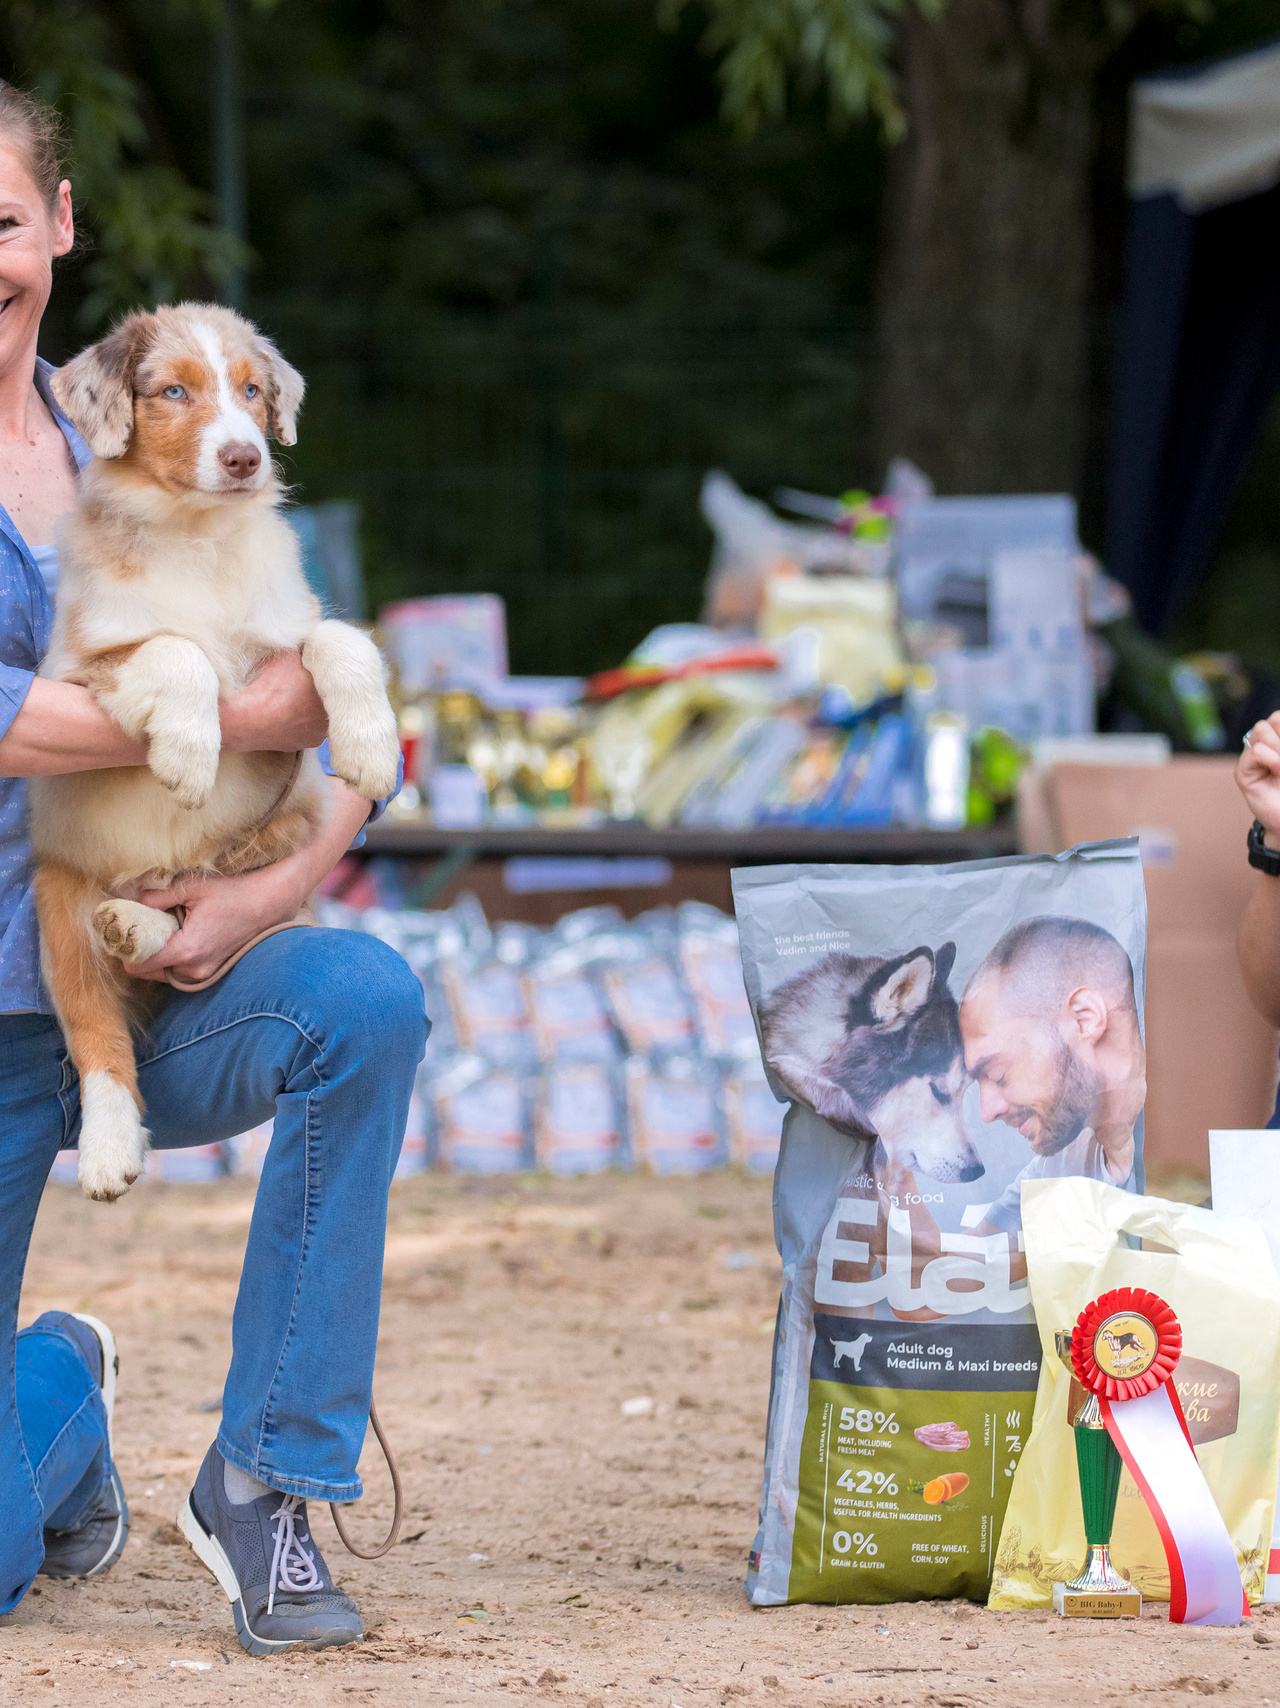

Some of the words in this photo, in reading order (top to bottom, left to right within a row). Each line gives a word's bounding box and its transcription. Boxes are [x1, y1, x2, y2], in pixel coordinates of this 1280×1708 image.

[774, 936, 791, 945] the
[793, 933, 814, 943] best
[816, 930, 850, 941] friends
[775, 945, 807, 956] Vadim
[809, 942, 827, 953] and
[829, 941, 851, 950] Nice
[904, 1191, 944, 1205] food
[814, 1198, 1032, 1315] Elá
[886, 1342, 924, 1354] Adult
[926, 1344, 953, 1358] dog
[886, 1357, 942, 1371] Medium
[944, 1360, 955, 1371] &
[958, 1360, 990, 1372] Maxi
[993, 1360, 1038, 1372] breeds
[839, 1407, 900, 1435] 58%
[819, 1429, 827, 1463] NATURAL
[837, 1446, 857, 1455] FRESH
[858, 1448, 876, 1456] MEAT
[858, 1438, 892, 1449] INCLUDING
[836, 1469, 899, 1496] 42%
[833, 1507, 857, 1517] USEFUL
[858, 1510, 872, 1518] FOR
[872, 1511, 898, 1520] HEALTH
[899, 1513, 942, 1522] INGREDIENTS
[832, 1530, 878, 1556] 0%
[911, 1543, 929, 1552] FREE
[930, 1544, 940, 1552] OF
[859, 1560, 885, 1569] GLUTEN
[934, 1556, 950, 1565] SOY
